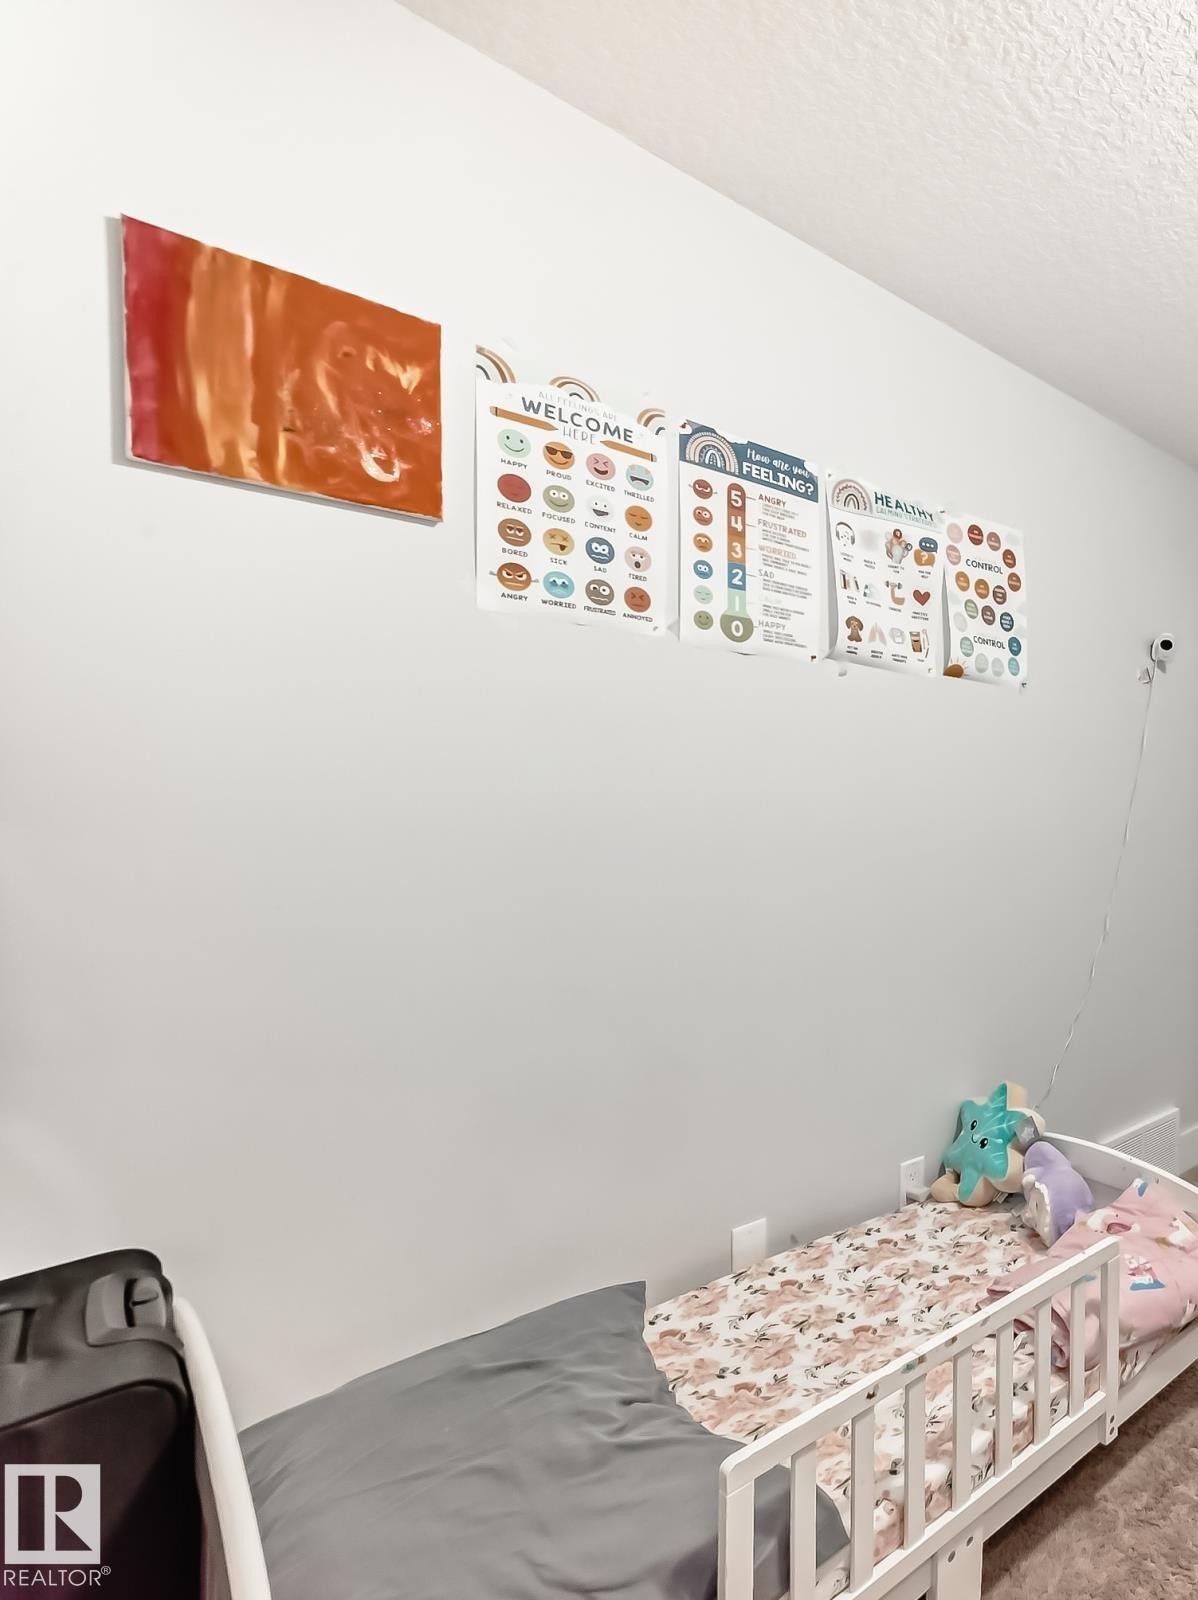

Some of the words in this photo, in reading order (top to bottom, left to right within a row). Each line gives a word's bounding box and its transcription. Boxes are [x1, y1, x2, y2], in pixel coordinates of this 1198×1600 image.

[521, 396, 634, 444] WELCOME
[500, 458, 528, 469] HAPPY
[746, 447, 770, 464] How
[772, 458, 791, 472] are
[792, 464, 810, 479] you
[546, 469, 572, 481] PROUD
[742, 461, 814, 495] FEELING?
[585, 479, 616, 492] EXCITED
[623, 490, 655, 503] THRILLED
[730, 489, 743, 508] 5
[758, 493, 787, 508] ANGRY
[496, 501, 532, 515] RELAXED
[874, 491, 934, 521] HEALTHY
[542, 511, 576, 524] FOCUSED
[731, 515, 743, 532] 4
[584, 521, 616, 534] CONTENT
[758, 518, 807, 538] FRUSTRATED
[628, 532, 648, 542] CALM
[501, 547, 529, 558] BORED
[730, 542, 743, 559] 3
[549, 557, 568, 566] SICK
[965, 558, 1003, 574] CONTROL
[628, 572, 648, 582] TIRED
[731, 568, 743, 586] 2
[758, 569, 775, 580] SAD
[500, 592, 528, 602] ANGRY
[541, 599, 577, 610] WORRIED
[731, 620, 743, 637] 0
[973, 635, 1006, 650] CONTROL
